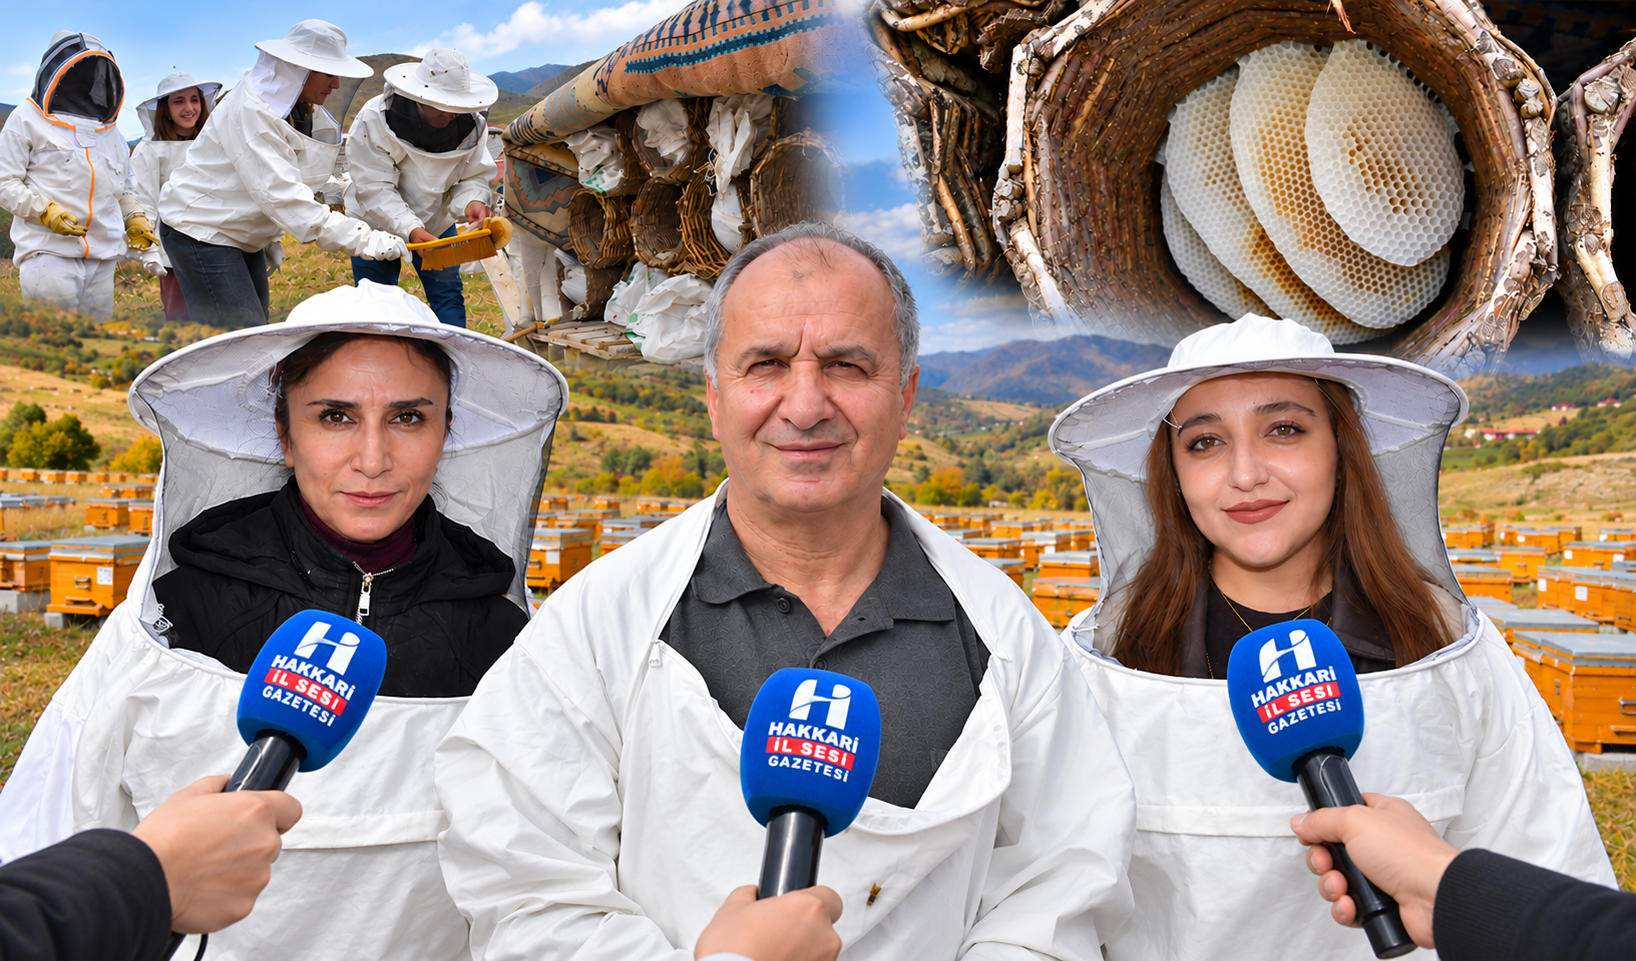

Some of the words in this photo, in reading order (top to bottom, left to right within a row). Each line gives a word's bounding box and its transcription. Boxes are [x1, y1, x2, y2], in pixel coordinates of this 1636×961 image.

[271, 655, 355, 701] HAKKARİ
[272, 670, 288, 686] İL
[1251, 666, 1337, 708] HAKKARİ
[262, 686, 336, 727] GAZETESİ
[1265, 705, 1283, 718] İL
[1268, 699, 1341, 734] GAZETESİ
[768, 722, 859, 754] HAKKARİ
[774, 738, 792, 753] İL
[801, 742, 847, 766] SESİ
[768, 755, 849, 782] GAZETESİ
